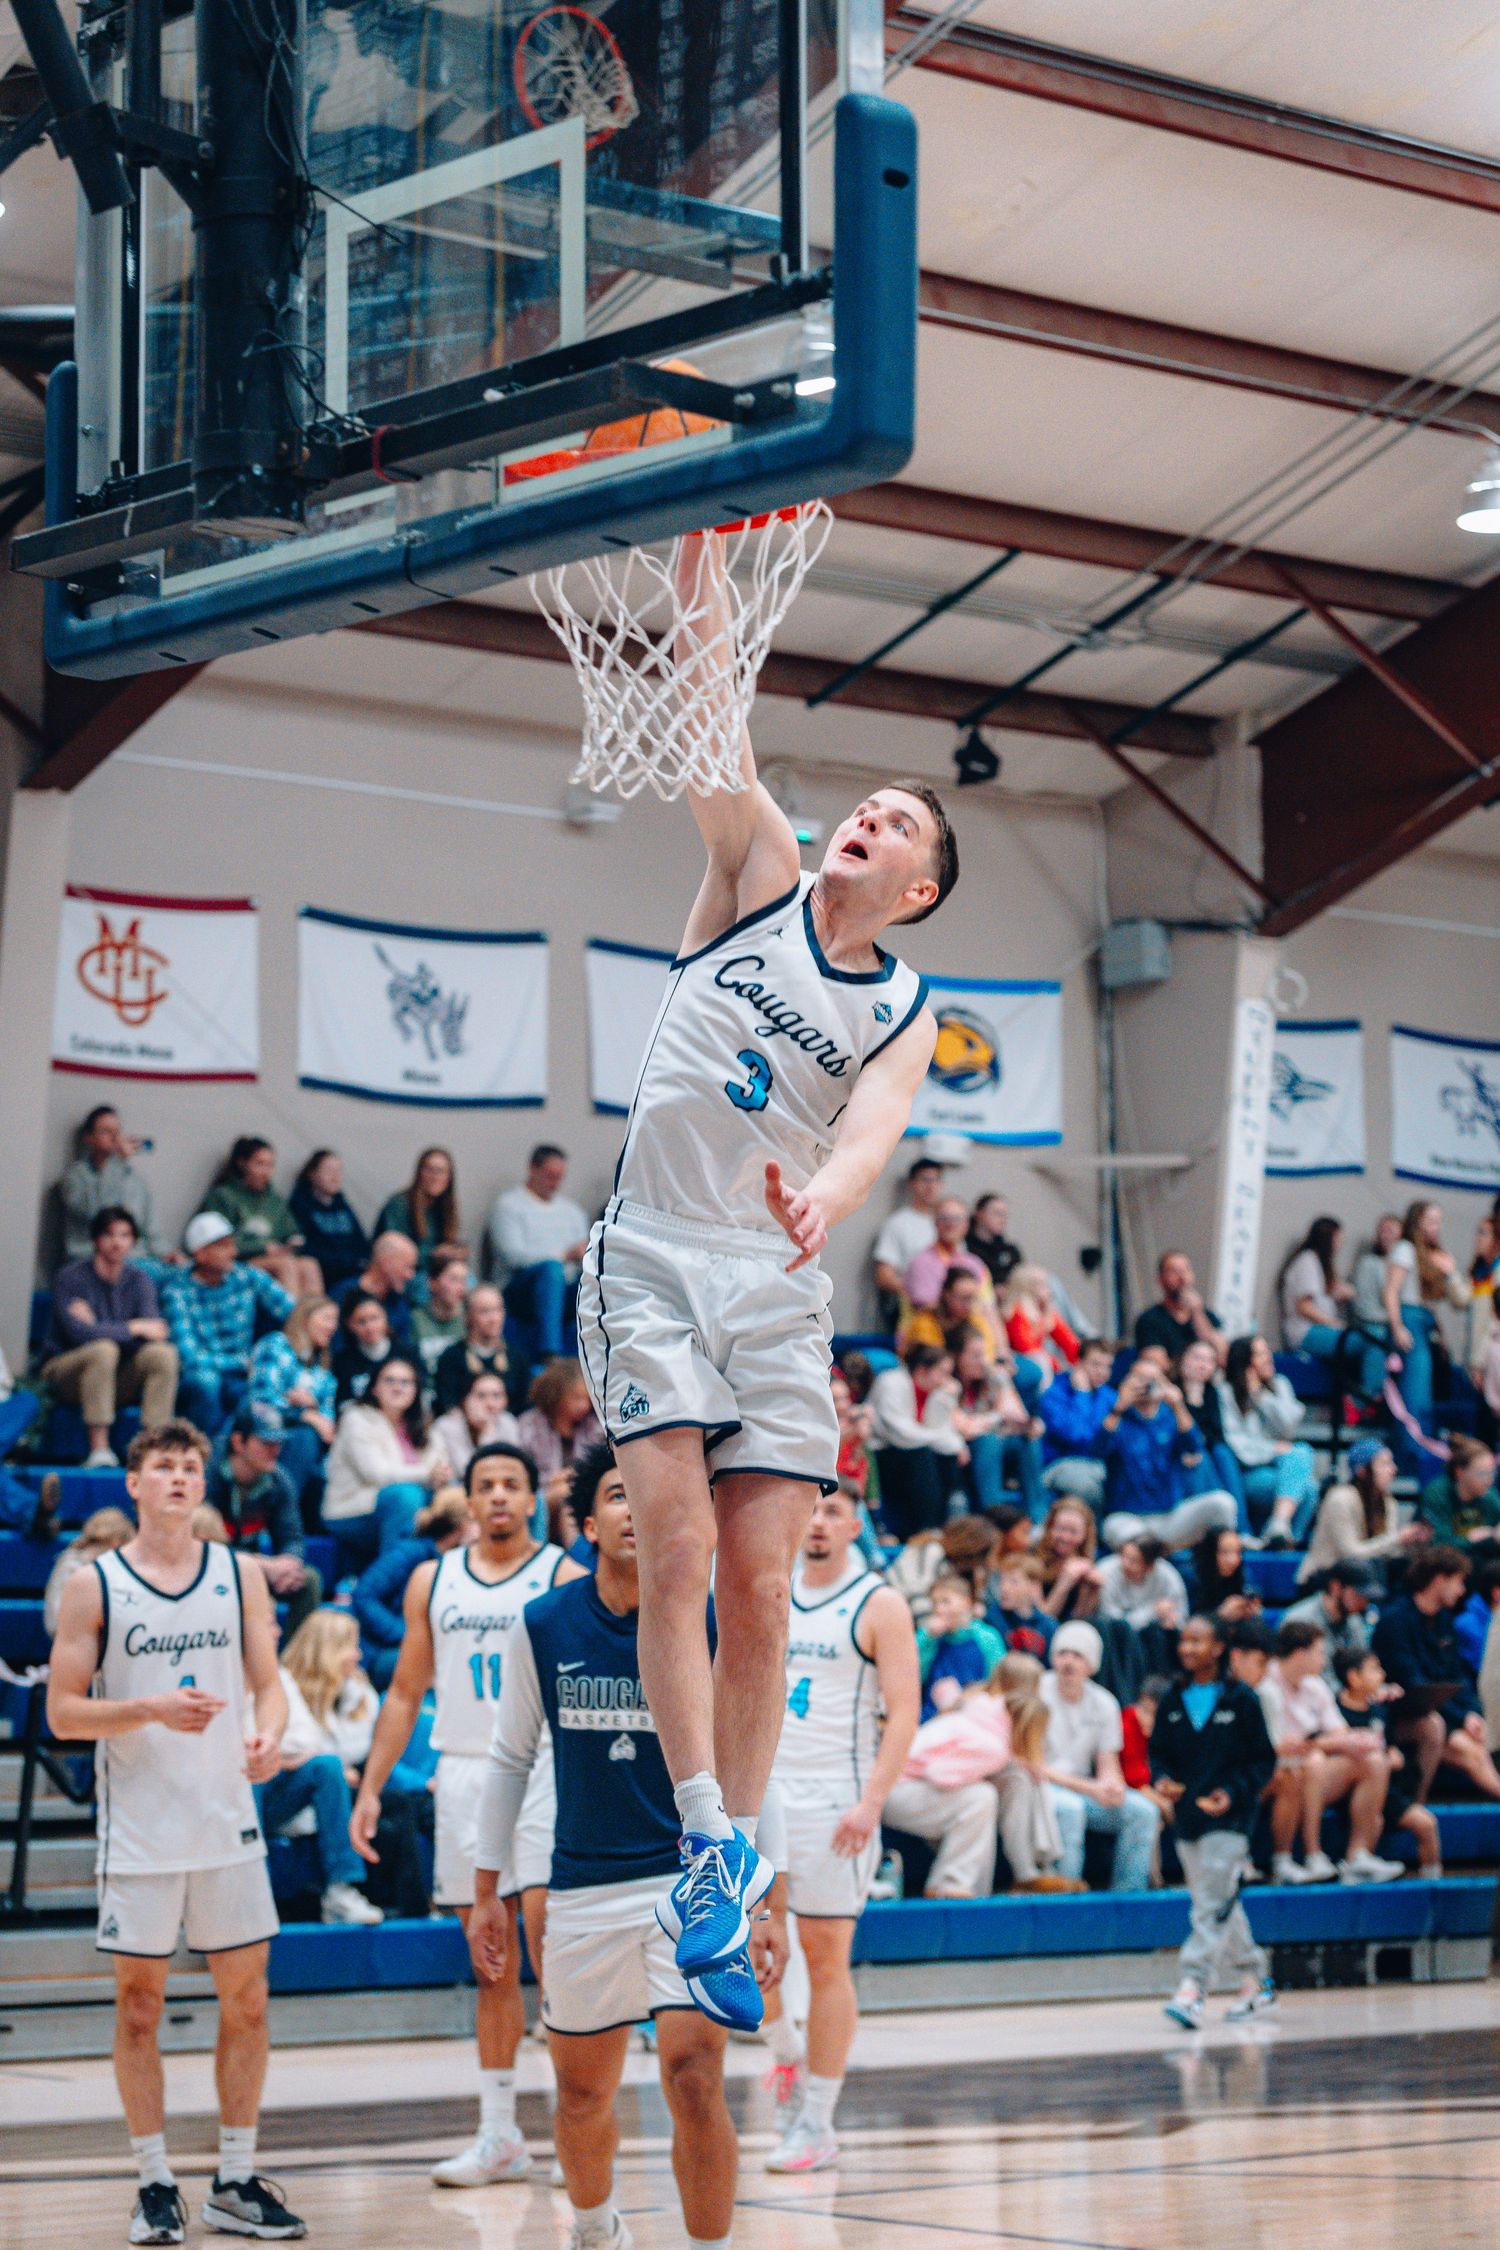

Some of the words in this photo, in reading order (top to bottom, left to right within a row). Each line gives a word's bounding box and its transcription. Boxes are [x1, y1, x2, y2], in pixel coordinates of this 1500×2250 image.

[714, 955, 852, 1078] Cougars
[724, 1047, 774, 1112] 3
[124, 1623, 231, 1667] Cougars
[469, 1652, 502, 1701] 11
[556, 1674, 650, 1711] COUGA
[560, 1712, 652, 1728] BASKETB
